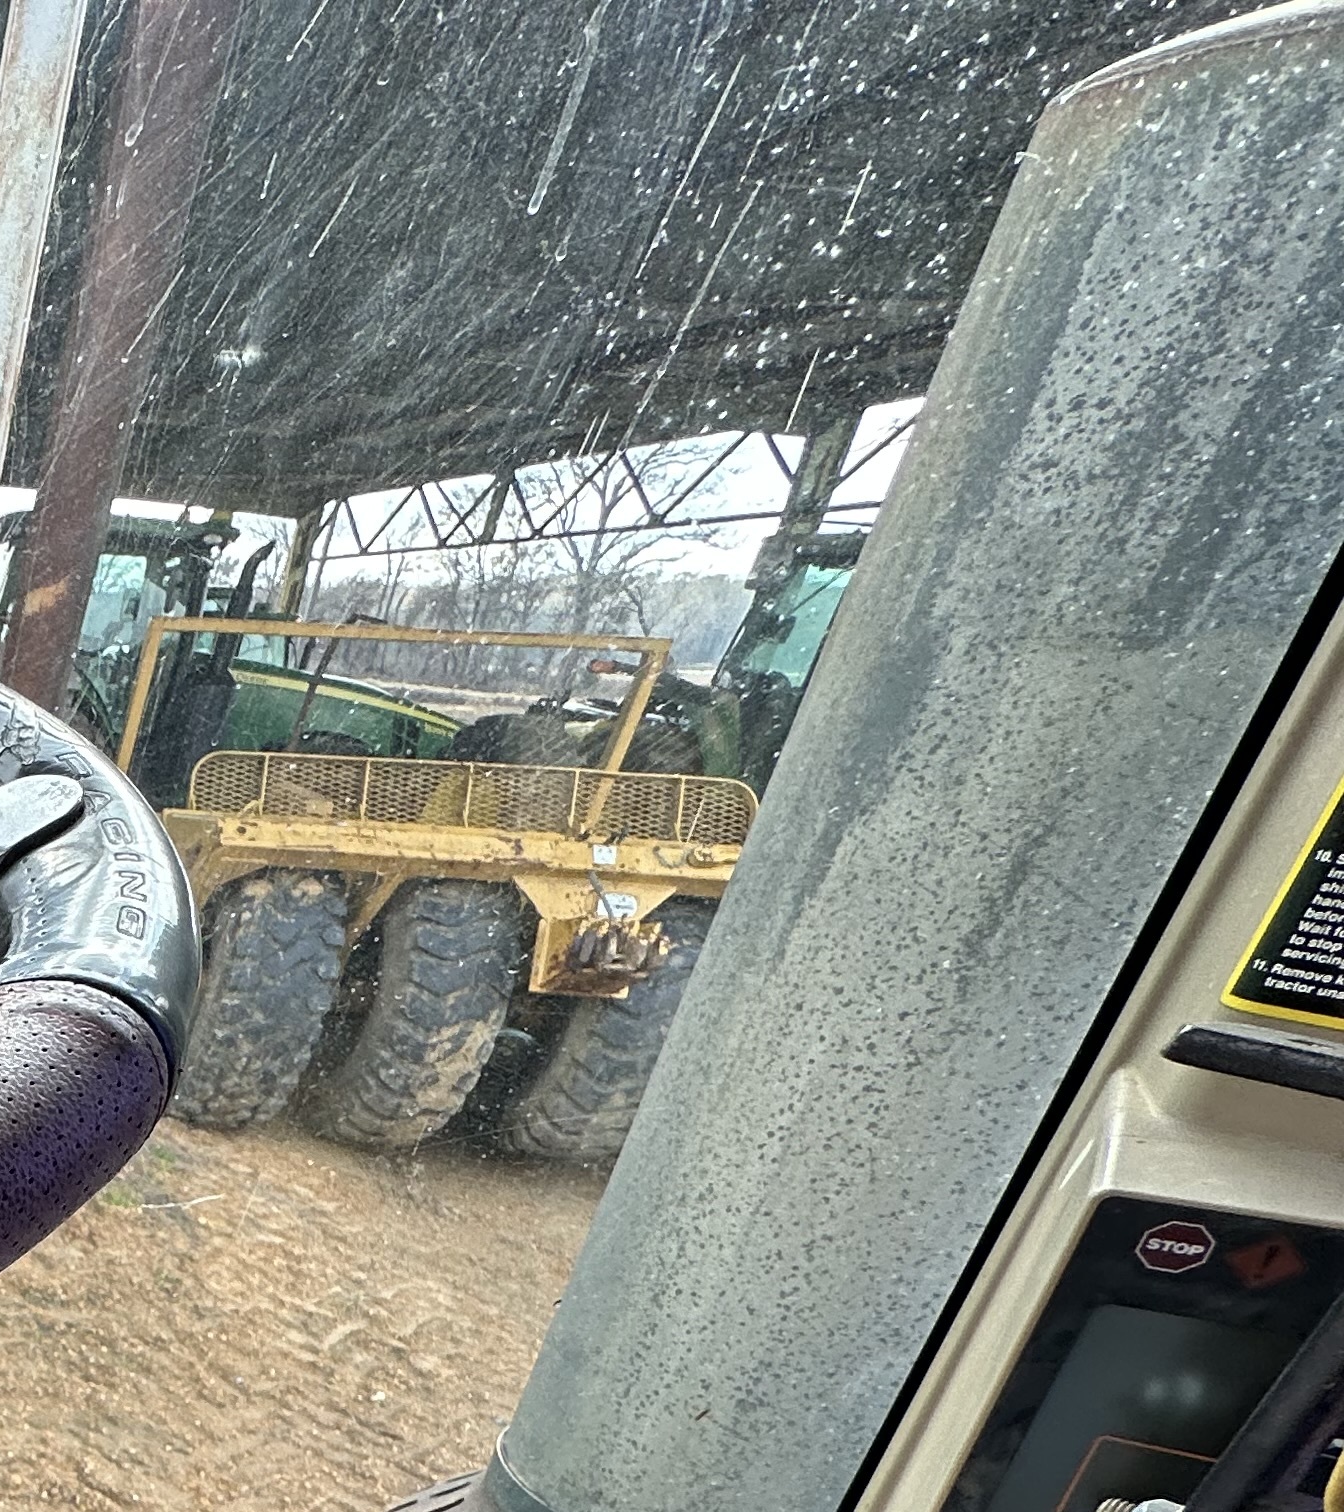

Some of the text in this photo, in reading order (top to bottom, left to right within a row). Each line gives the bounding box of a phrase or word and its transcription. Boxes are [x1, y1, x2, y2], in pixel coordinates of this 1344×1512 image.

[1298, 920, 1332, 935] Wait
[1289, 934, 1343, 953] to stop
[1252, 959, 1268, 972] 11.
[1270, 963, 1333, 983] Remove
[1264, 976, 1316, 993] tractor
[1146, 1238, 1205, 1255] STOP
